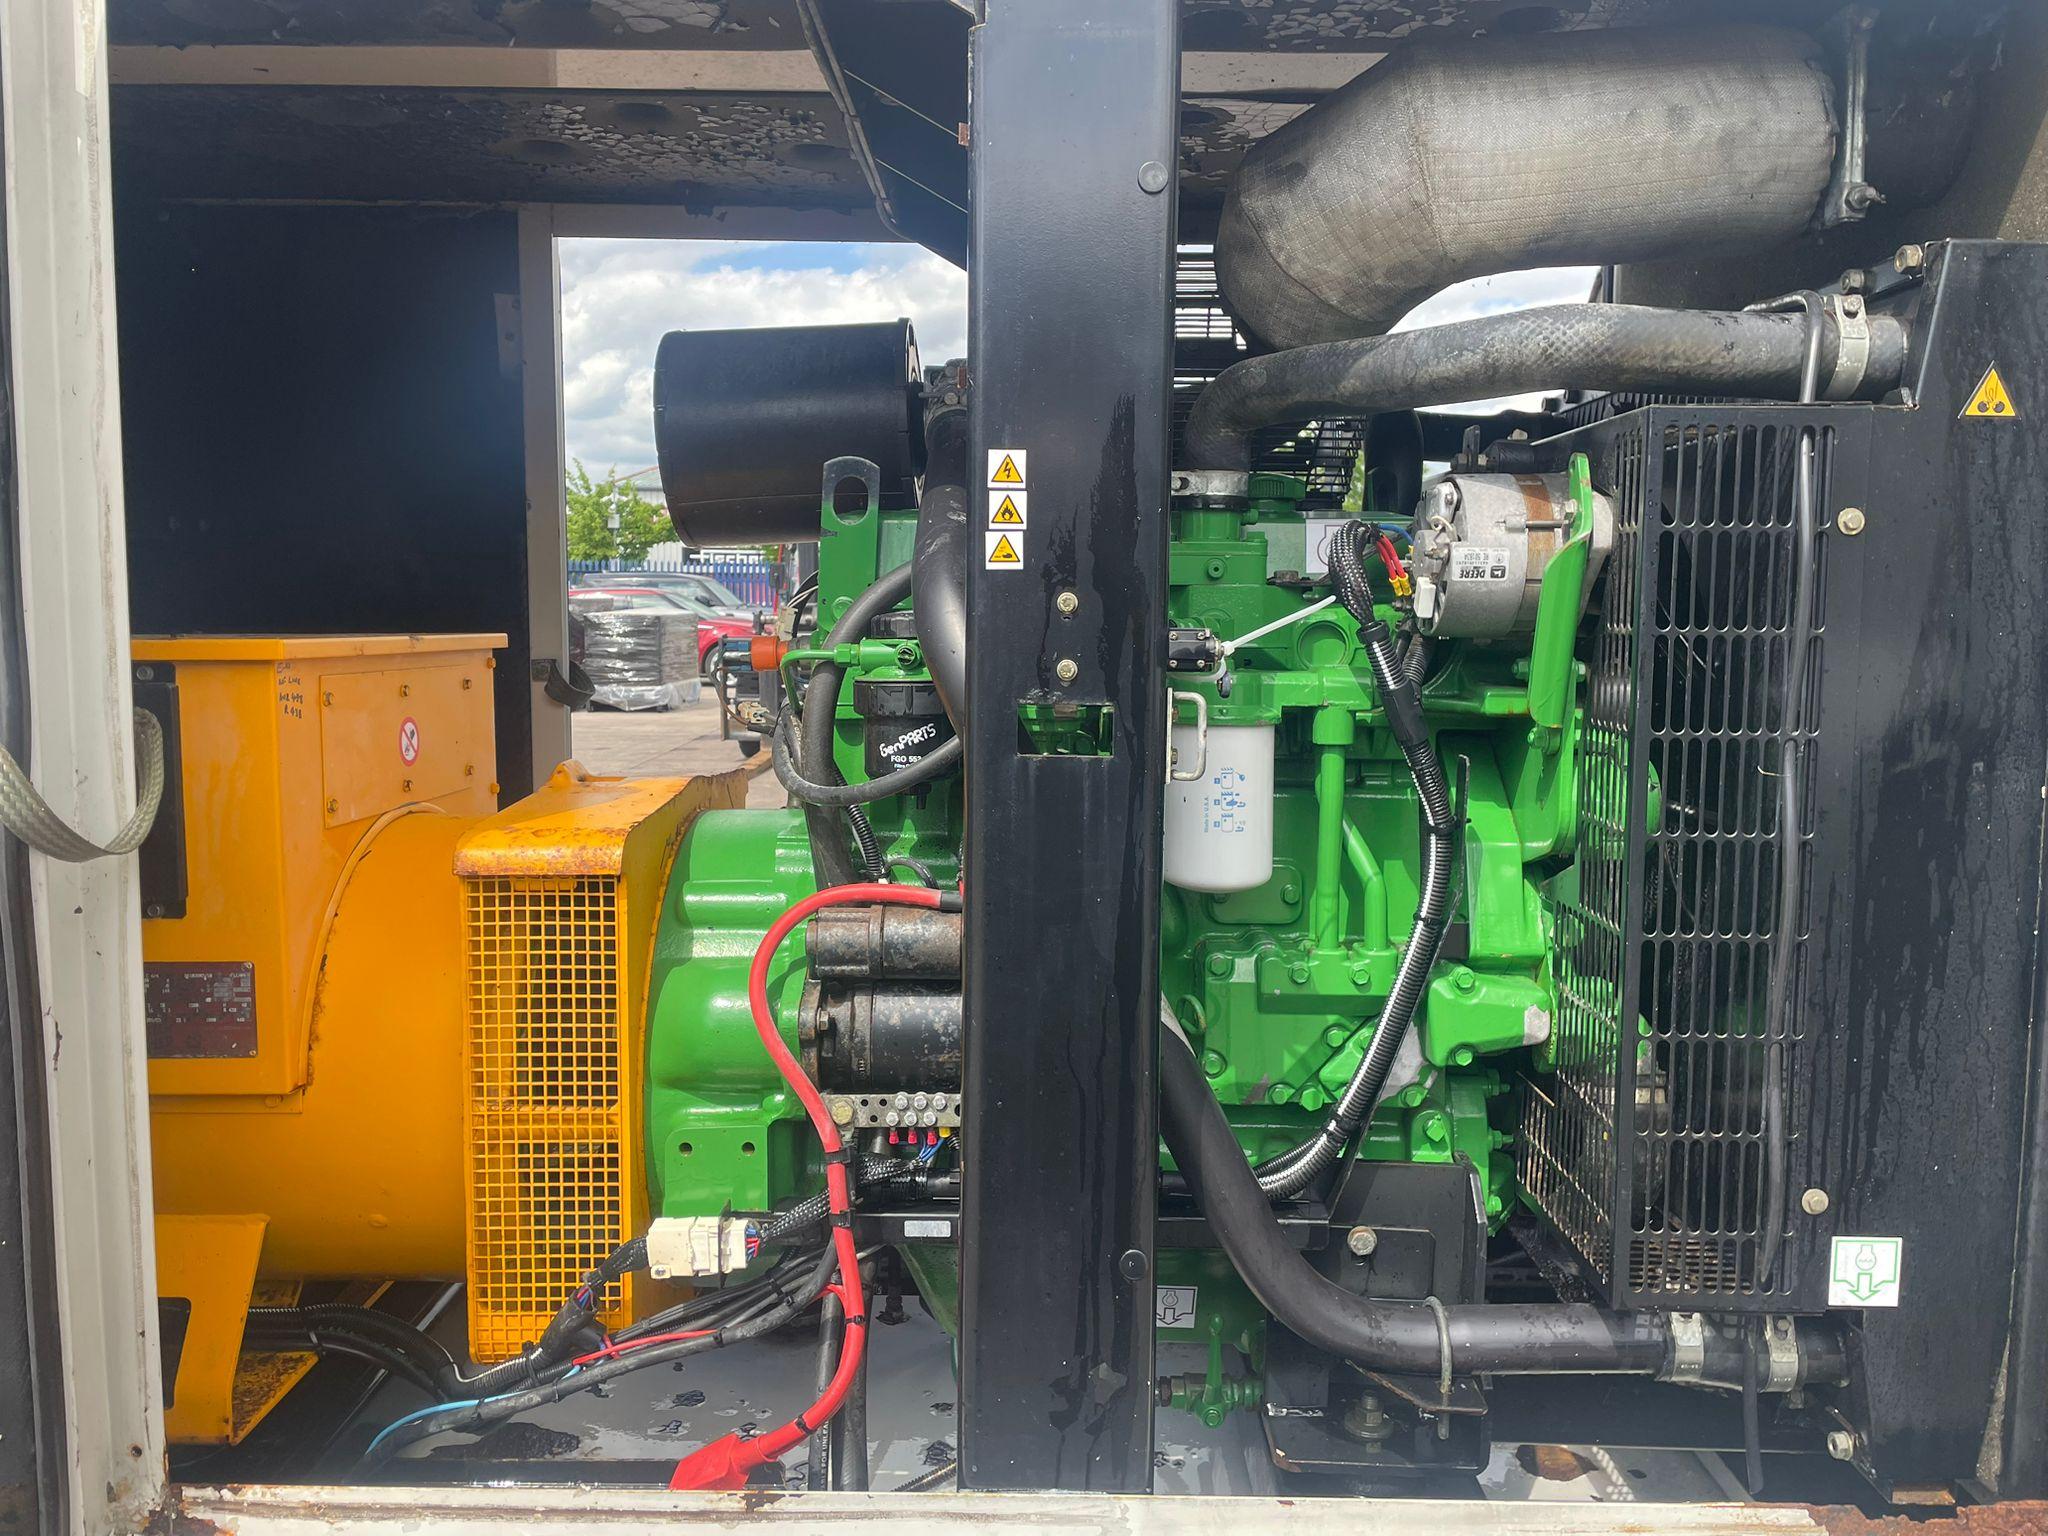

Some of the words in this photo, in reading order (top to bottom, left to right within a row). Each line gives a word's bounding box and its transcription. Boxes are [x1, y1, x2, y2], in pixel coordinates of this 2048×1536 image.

[1459, 569, 1486, 579] DEERE
[879, 723, 937, 757] GenPARTS
[890, 755, 907, 763] FGO
